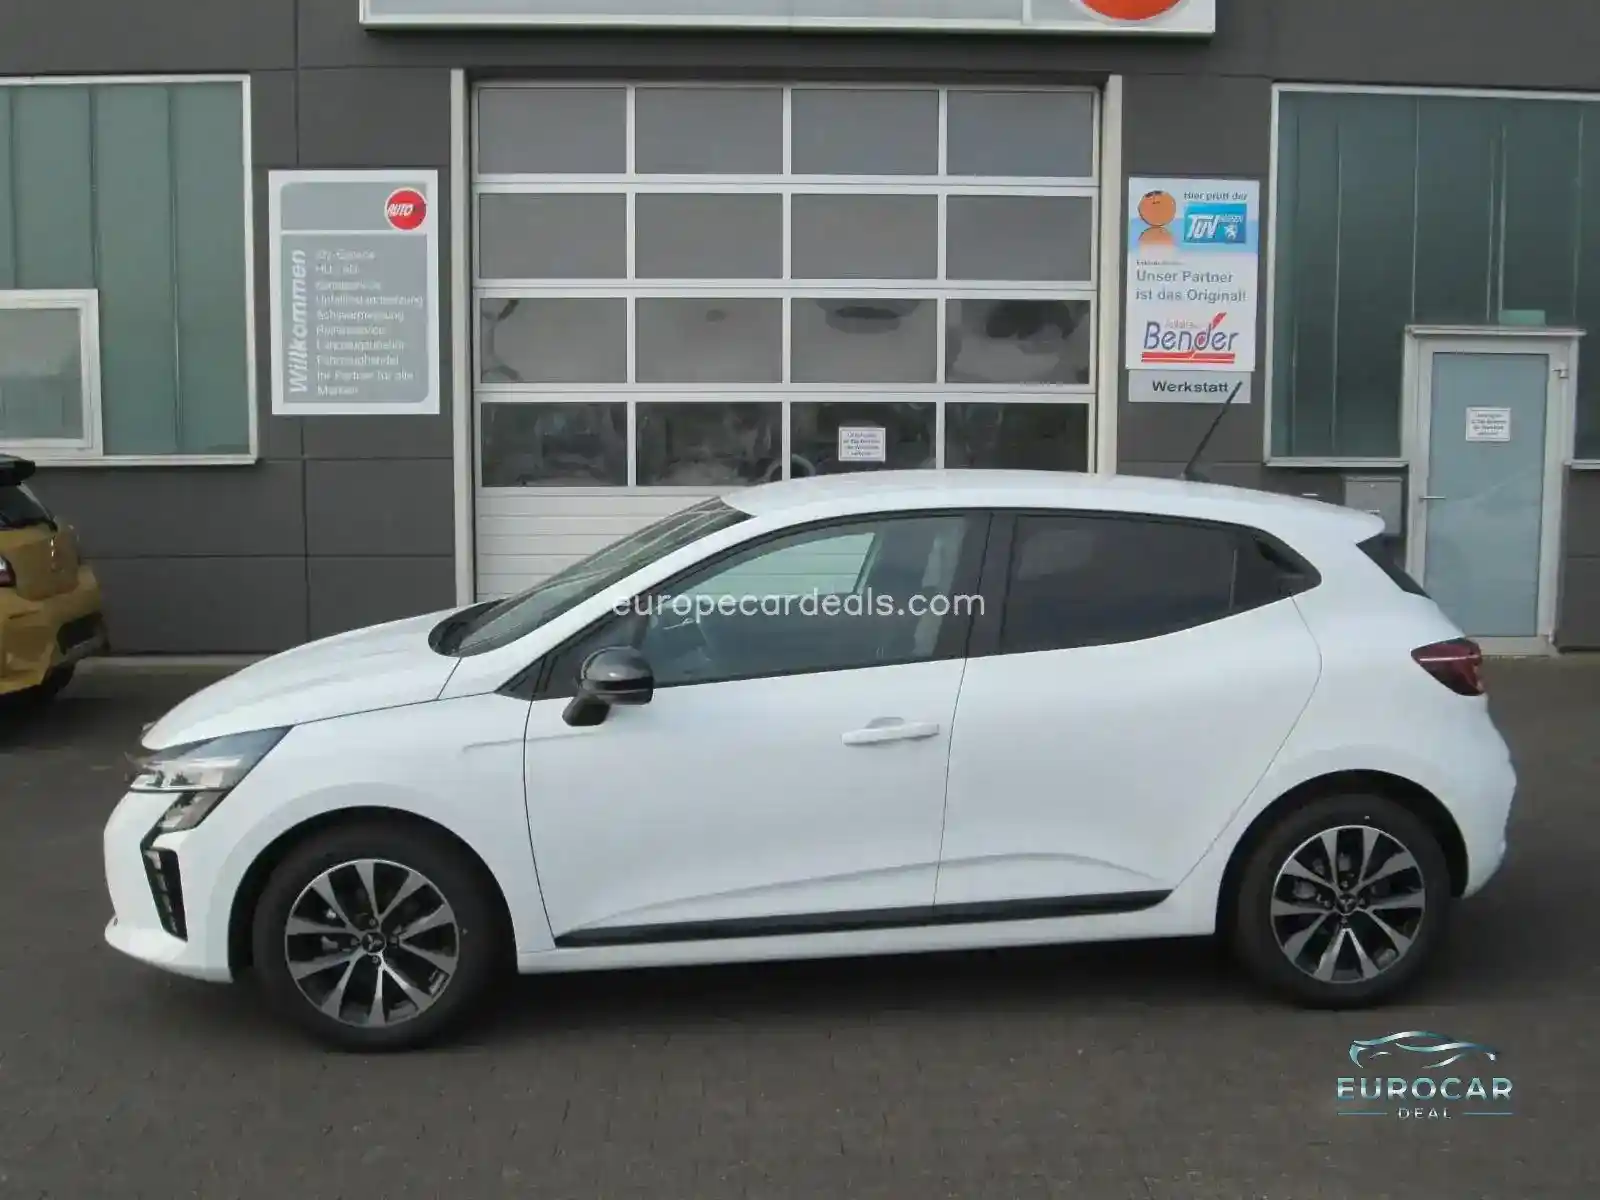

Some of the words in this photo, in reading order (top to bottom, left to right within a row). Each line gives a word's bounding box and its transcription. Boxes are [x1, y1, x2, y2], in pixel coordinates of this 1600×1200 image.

[1136, 269, 1178, 282] Unser
[1182, 270, 1234, 283] Partner
[1136, 288, 1152, 300] ist
[1157, 287, 1182, 300] das
[1187, 288, 1247, 304] Original!
[288, 249, 308, 393] Willkommen
[1143, 318, 1240, 351] Bender
[1152, 380, 1229, 393] Werkstatt
